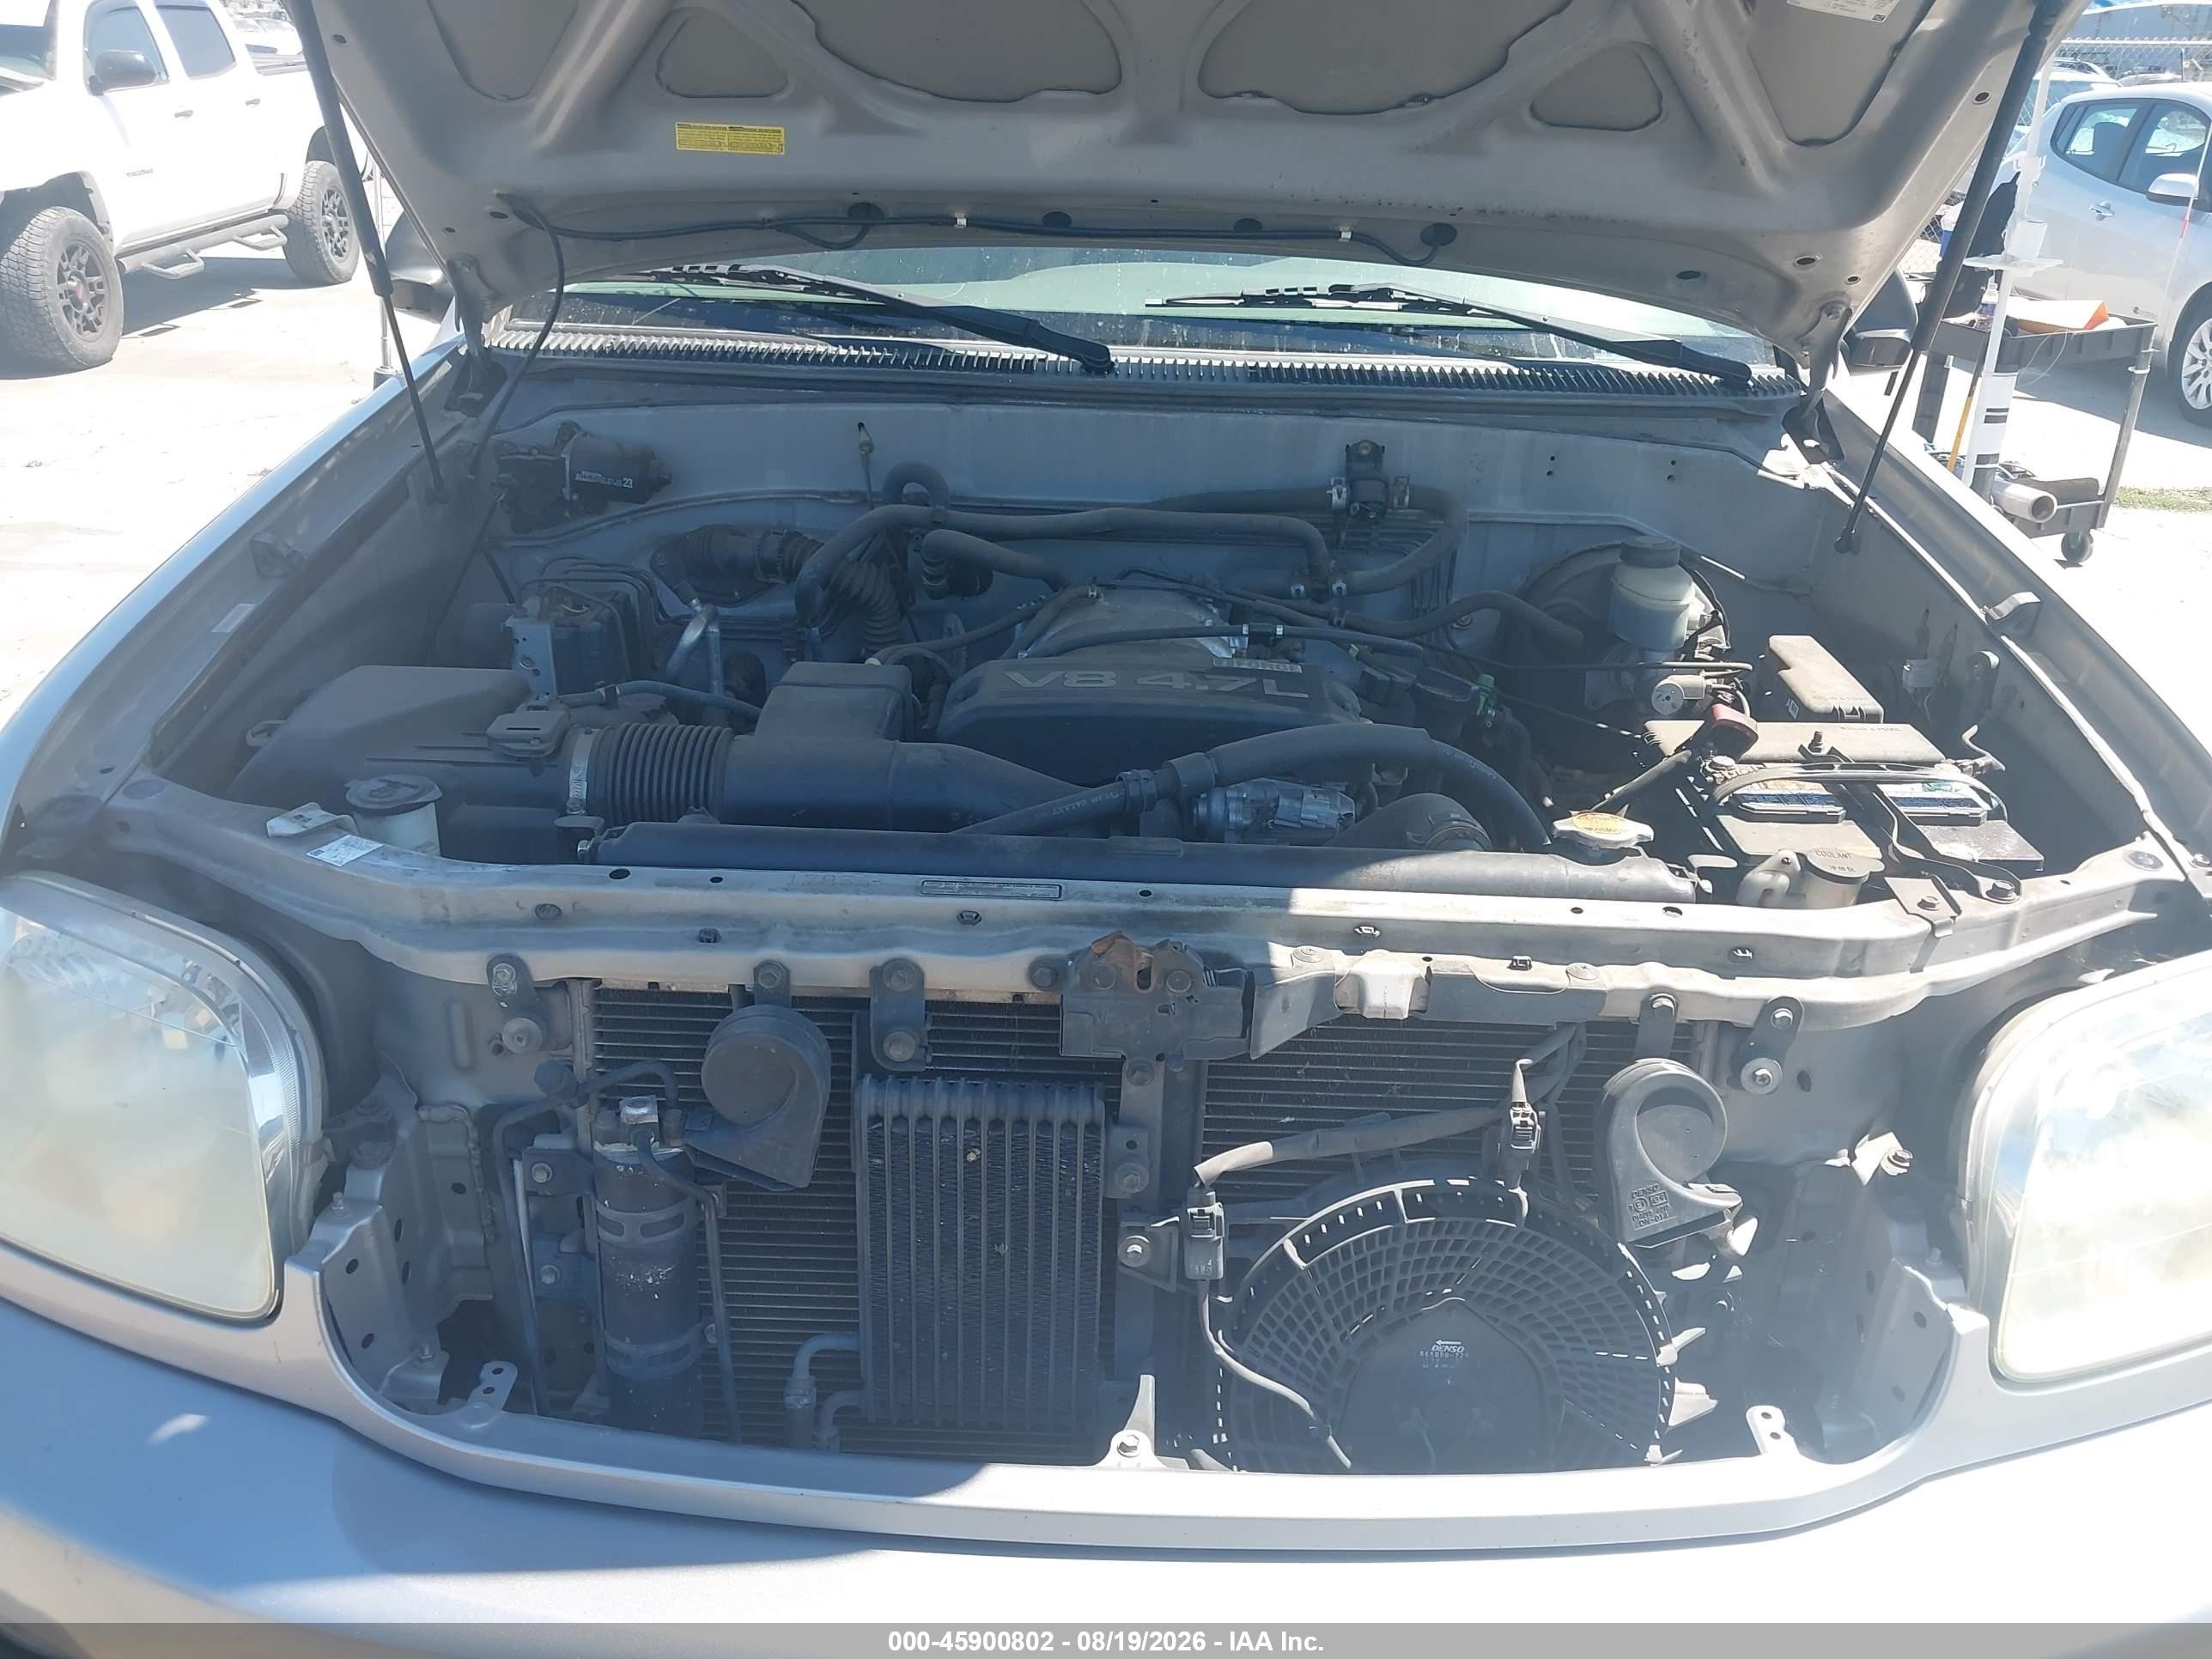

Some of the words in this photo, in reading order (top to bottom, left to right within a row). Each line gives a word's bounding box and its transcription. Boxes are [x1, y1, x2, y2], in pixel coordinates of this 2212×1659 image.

[1004, 671, 1117, 689] V8
[1137, 672, 1310, 698] 4.7L
[1814, 850, 1853, 860] COOLANT
[1431, 1345, 1465, 1353] DENSO
